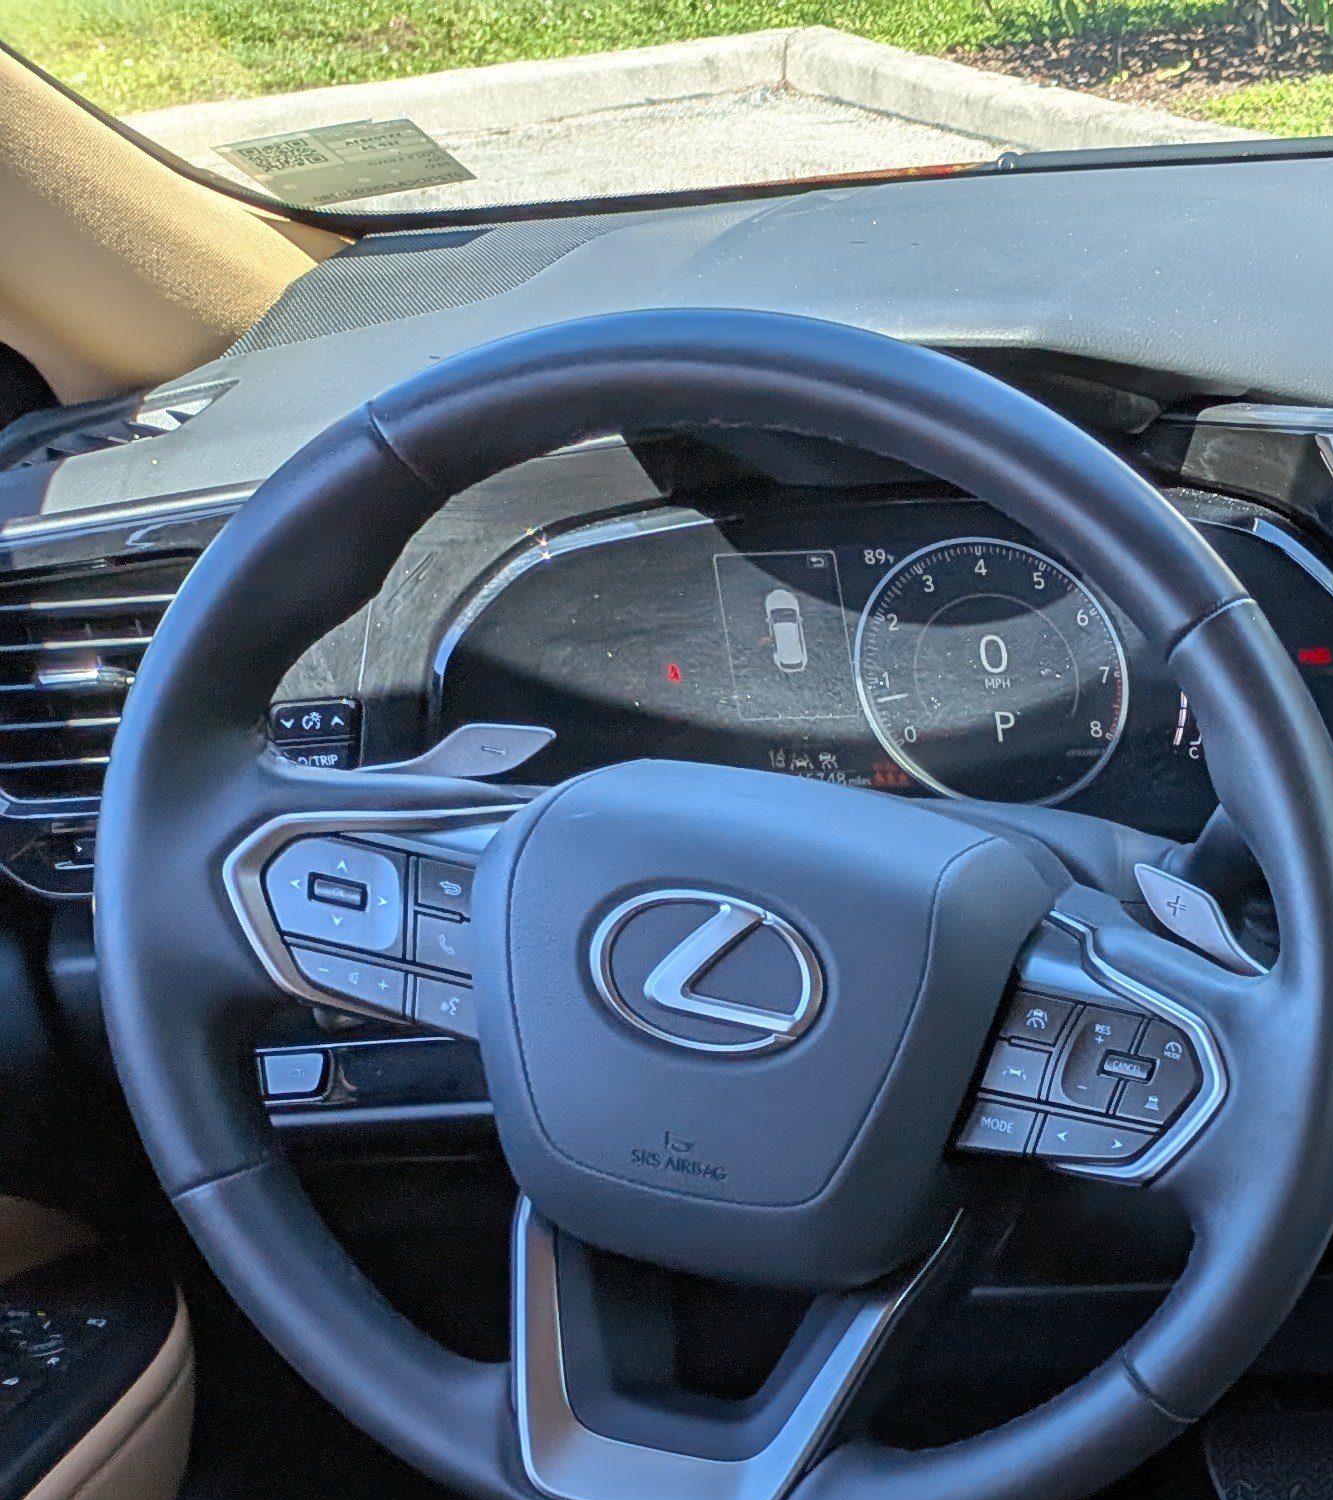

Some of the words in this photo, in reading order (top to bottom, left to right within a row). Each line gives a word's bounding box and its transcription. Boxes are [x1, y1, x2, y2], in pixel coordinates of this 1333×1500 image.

[974, 558, 988, 576] 4
[923, 575, 935, 593] 3
[1033, 571, 1046, 590] 5
[887, 613, 899, 631] 2
[1076, 608, 1090, 627] 6
[881, 671, 892, 689] 1
[984, 677, 1012, 690] MPH
[1098, 666, 1110, 684] 7
[904, 724, 917, 743] 0
[994, 711, 1015, 742] P
[1090, 720, 1103, 738] 8
[1095, 1023, 1111, 1036] RES
[981, 1116, 1015, 1135] MODE
[631, 1148, 661, 1168] SRS
